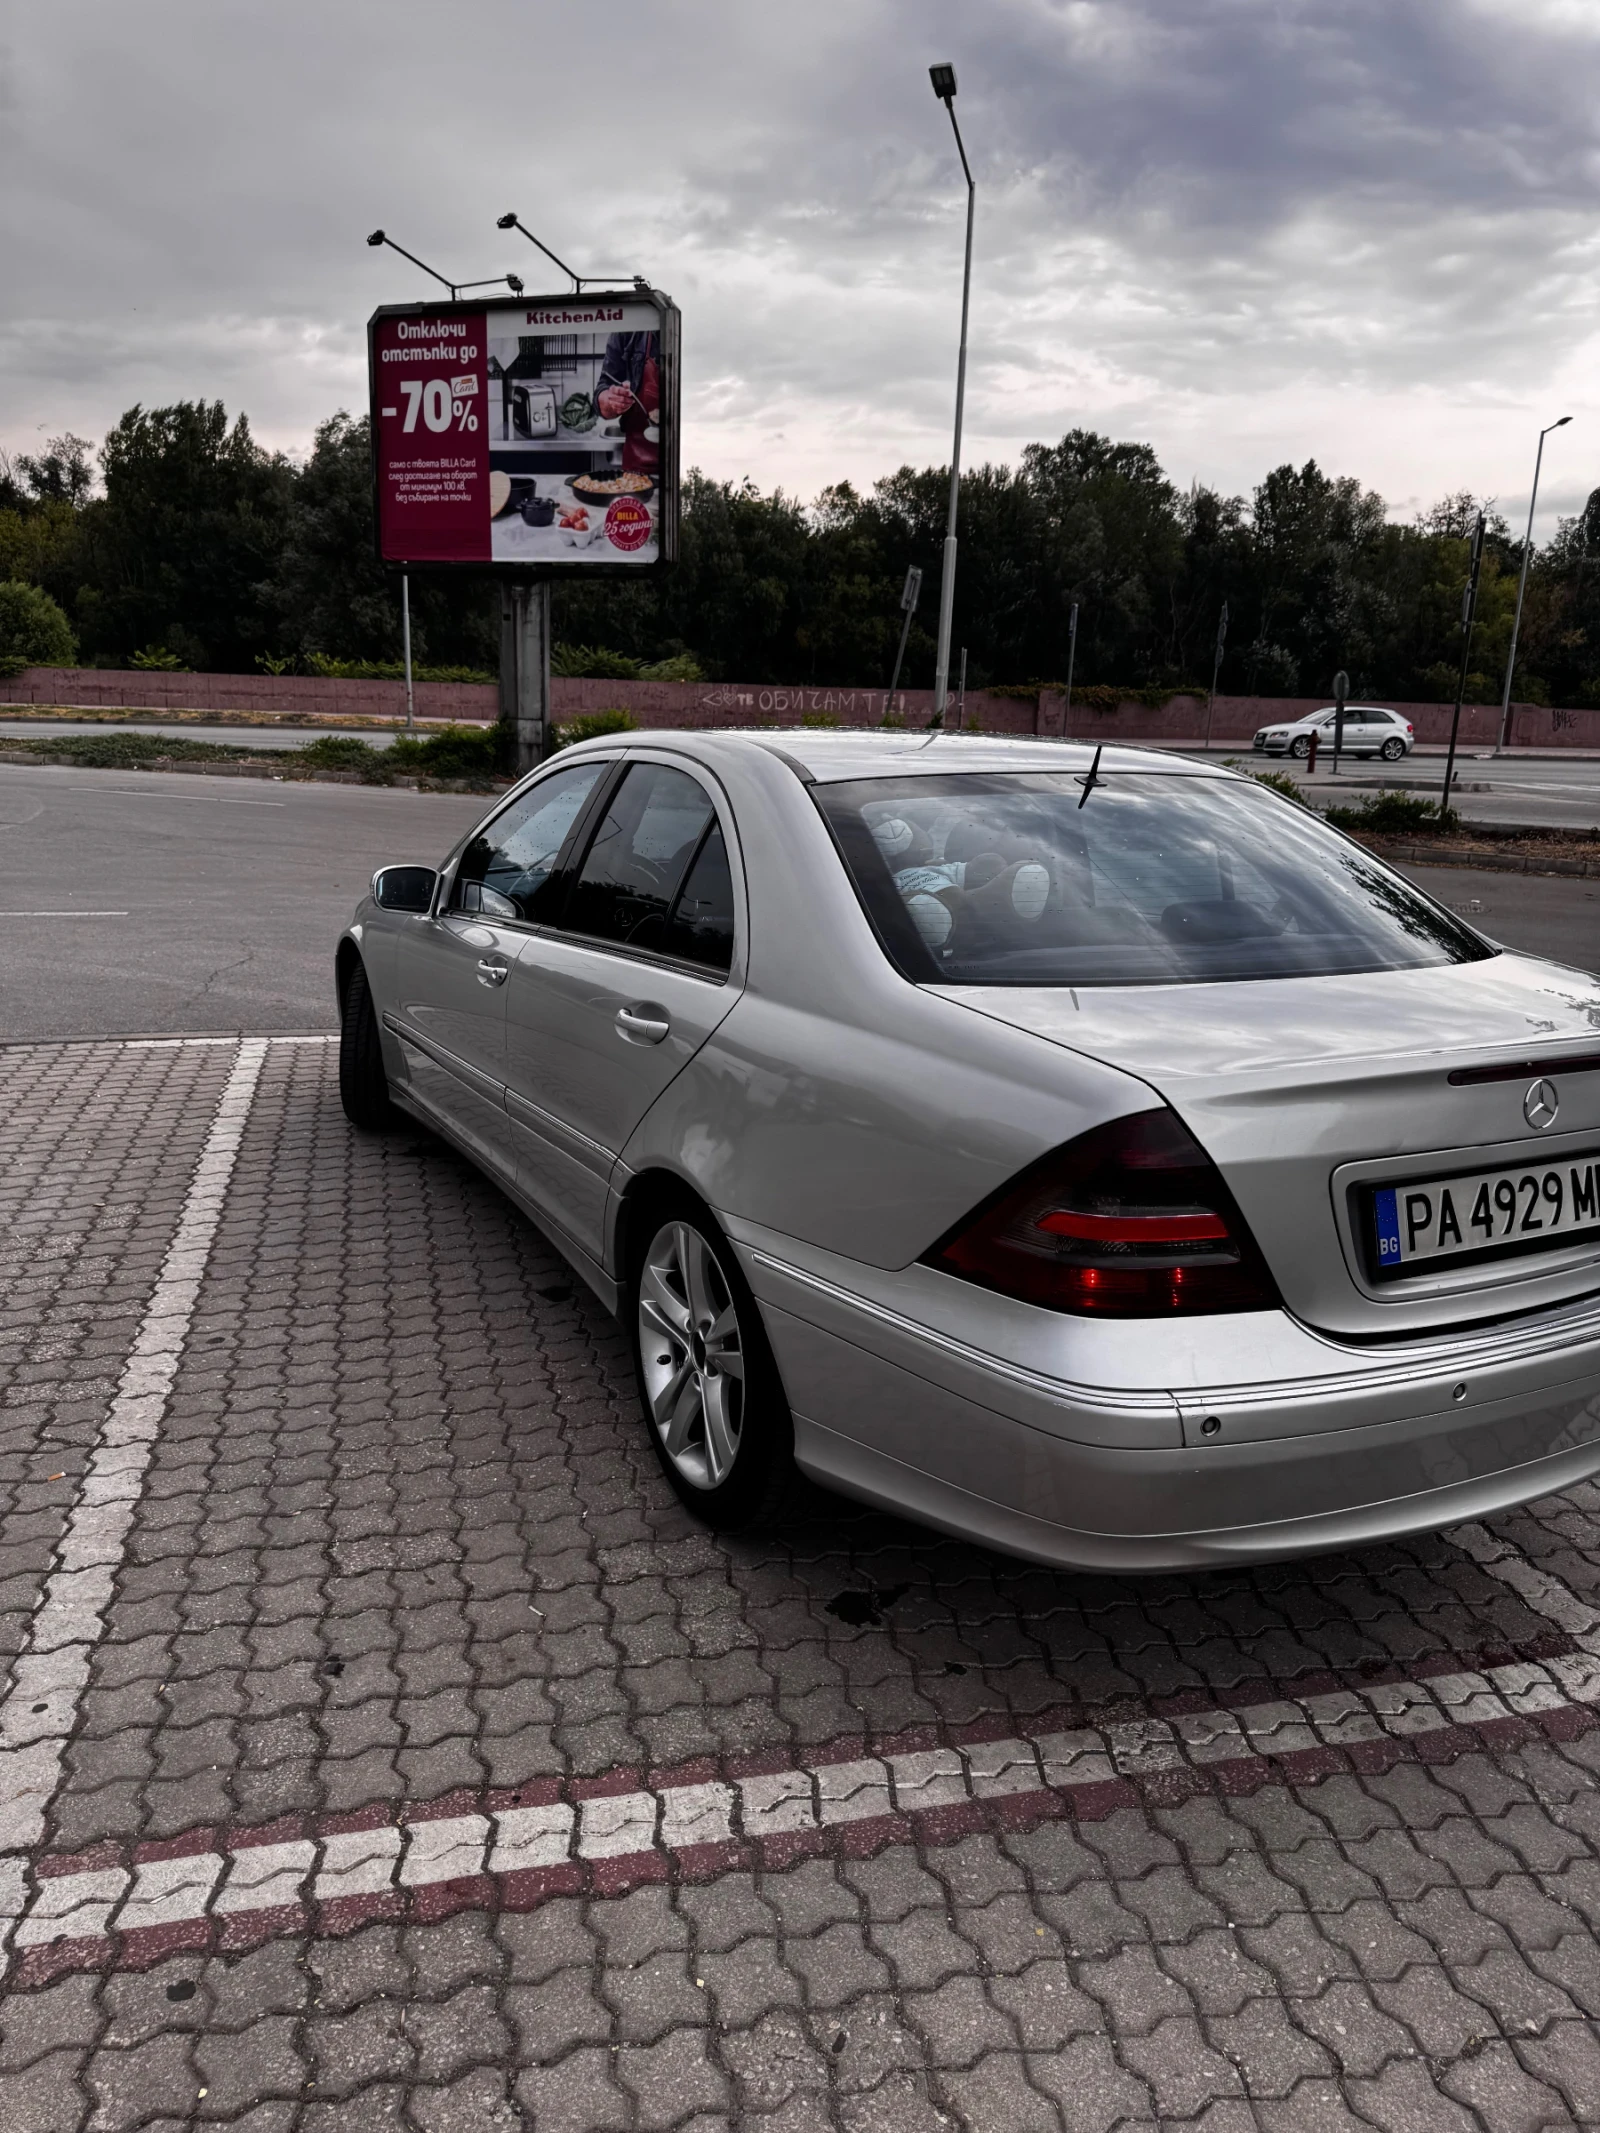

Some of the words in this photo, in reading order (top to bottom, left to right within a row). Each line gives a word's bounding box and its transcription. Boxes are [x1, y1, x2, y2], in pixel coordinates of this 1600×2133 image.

[526, 308, 624, 325] KitchenAid
[397, 320, 467, 340] Отключи
[381, 341, 457, 362] отстъпки
[460, 345, 478, 365] до
[381, 379, 478, 433] -70%
[389, 461, 406, 469] само
[406, 461, 412, 469] с
[412, 458, 440, 468] твоята
[440, 458, 459, 468] BILLA
[460, 458, 476, 468] Card
[388, 472, 404, 483] след
[404, 472, 441, 483] достигане
[451, 470, 478, 481] оборот
[399, 483, 410, 491] от
[411, 483, 442, 493] минимум
[443, 481, 456, 491] 100
[395, 492, 408, 504] без
[408, 492, 440, 503] събиране
[449, 492, 471, 501] точки
[616, 511, 639, 520] BILLA
[603, 521, 619, 536] 25
[619, 520, 653, 536] години
[758, 690, 855, 712] ОБИЧАМ
[1404, 1187, 1463, 1253] PA
[1469, 1171, 1564, 1238] 4929
[1568, 1163, 1600, 1222] M
[1379, 1237, 1399, 1255] BG
